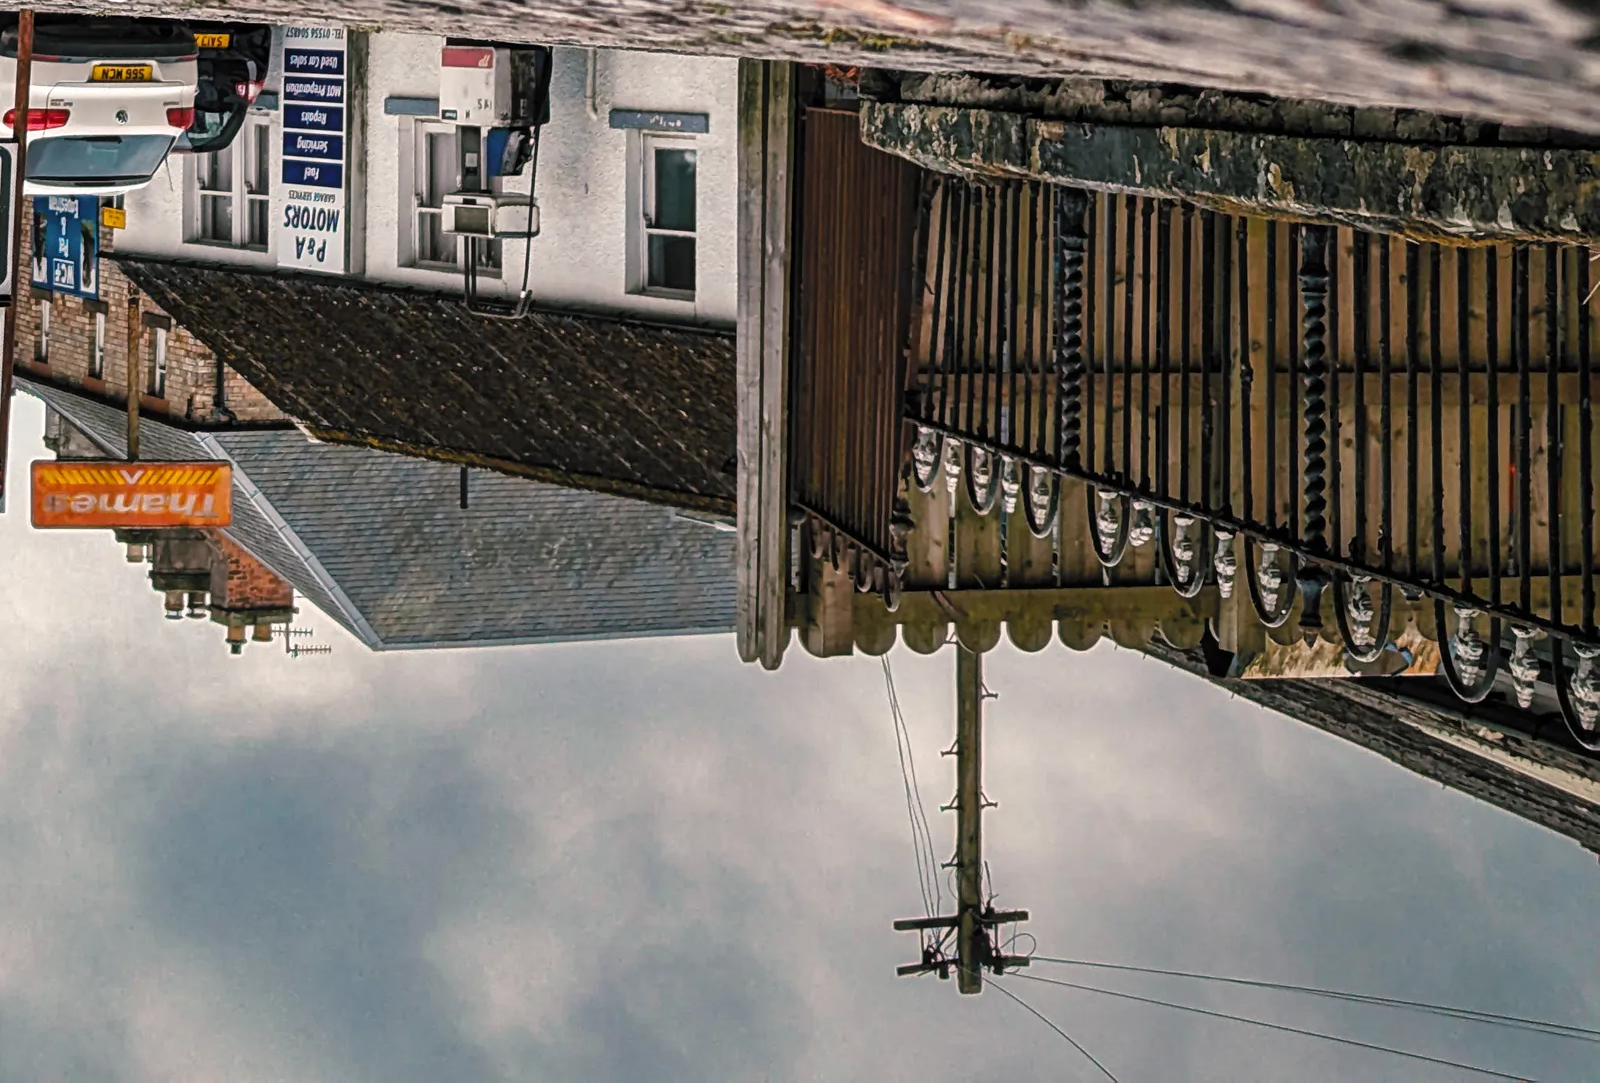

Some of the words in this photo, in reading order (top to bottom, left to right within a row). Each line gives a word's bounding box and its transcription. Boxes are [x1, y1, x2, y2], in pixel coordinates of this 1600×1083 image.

[289, 55, 308, 68] sales
[309, 56, 320, 68] Car
[321, 56, 338, 70] Used
[285, 81, 326, 96] Preparation
[327, 85, 341, 97] MOT
[301, 109, 327, 126] Repairs
[296, 135, 329, 153] Servicing
[304, 166, 320, 181] Fuel
[288, 190, 313, 202] SERVICES
[313, 191, 336, 204] GARAGE
[283, 204, 340, 233] MOTORS
